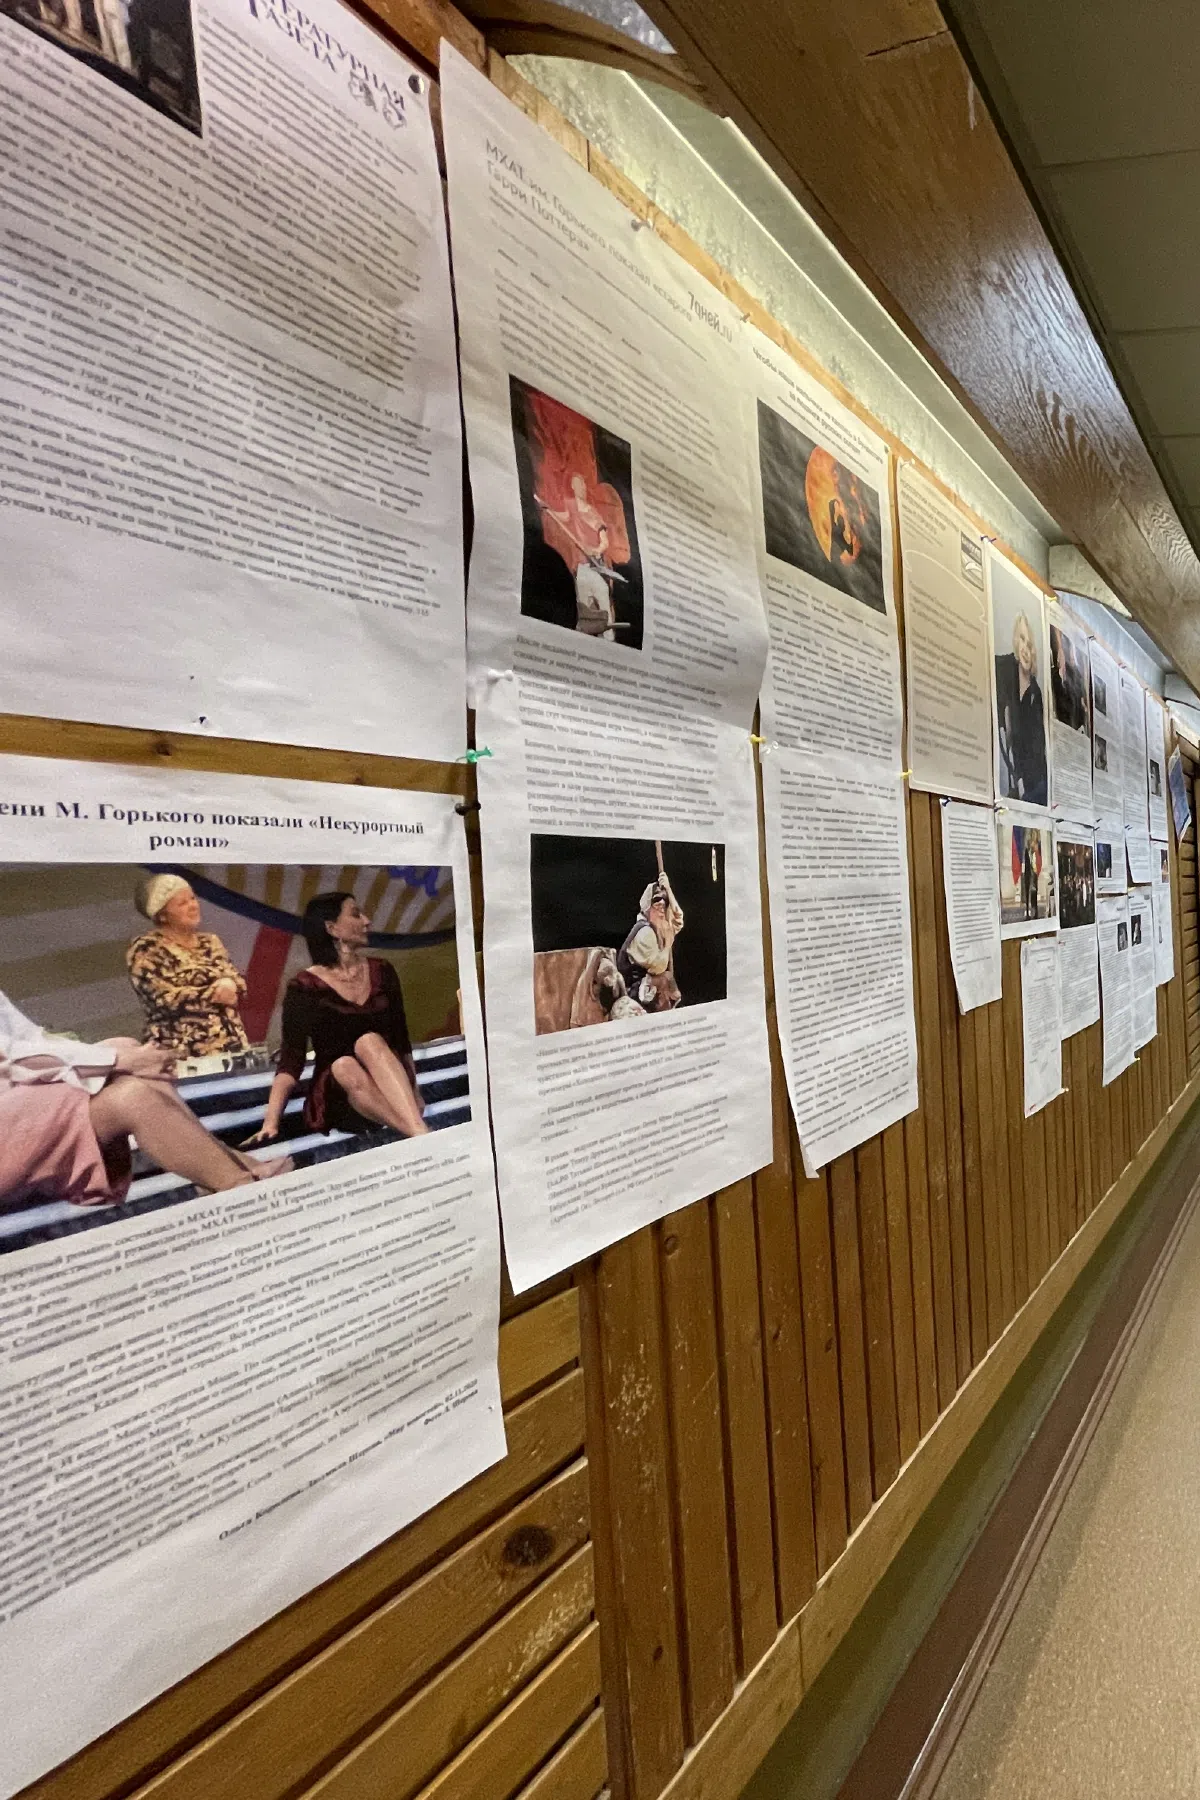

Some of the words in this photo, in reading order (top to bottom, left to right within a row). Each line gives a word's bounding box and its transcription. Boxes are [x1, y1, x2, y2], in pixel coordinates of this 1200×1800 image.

[270, 0, 405, 110] ЕРАТУРНАЯ
[486, 138, 524, 181] МХАТ
[552, 196, 605, 249] Горького
[487, 160, 527, 204] Гарри
[56, 801, 89, 819] М.
[99, 803, 204, 826] Горького
[212, 813, 303, 829] показали
[309, 815, 424, 836] «Некурортный
[149, 834, 230, 850] роман»
